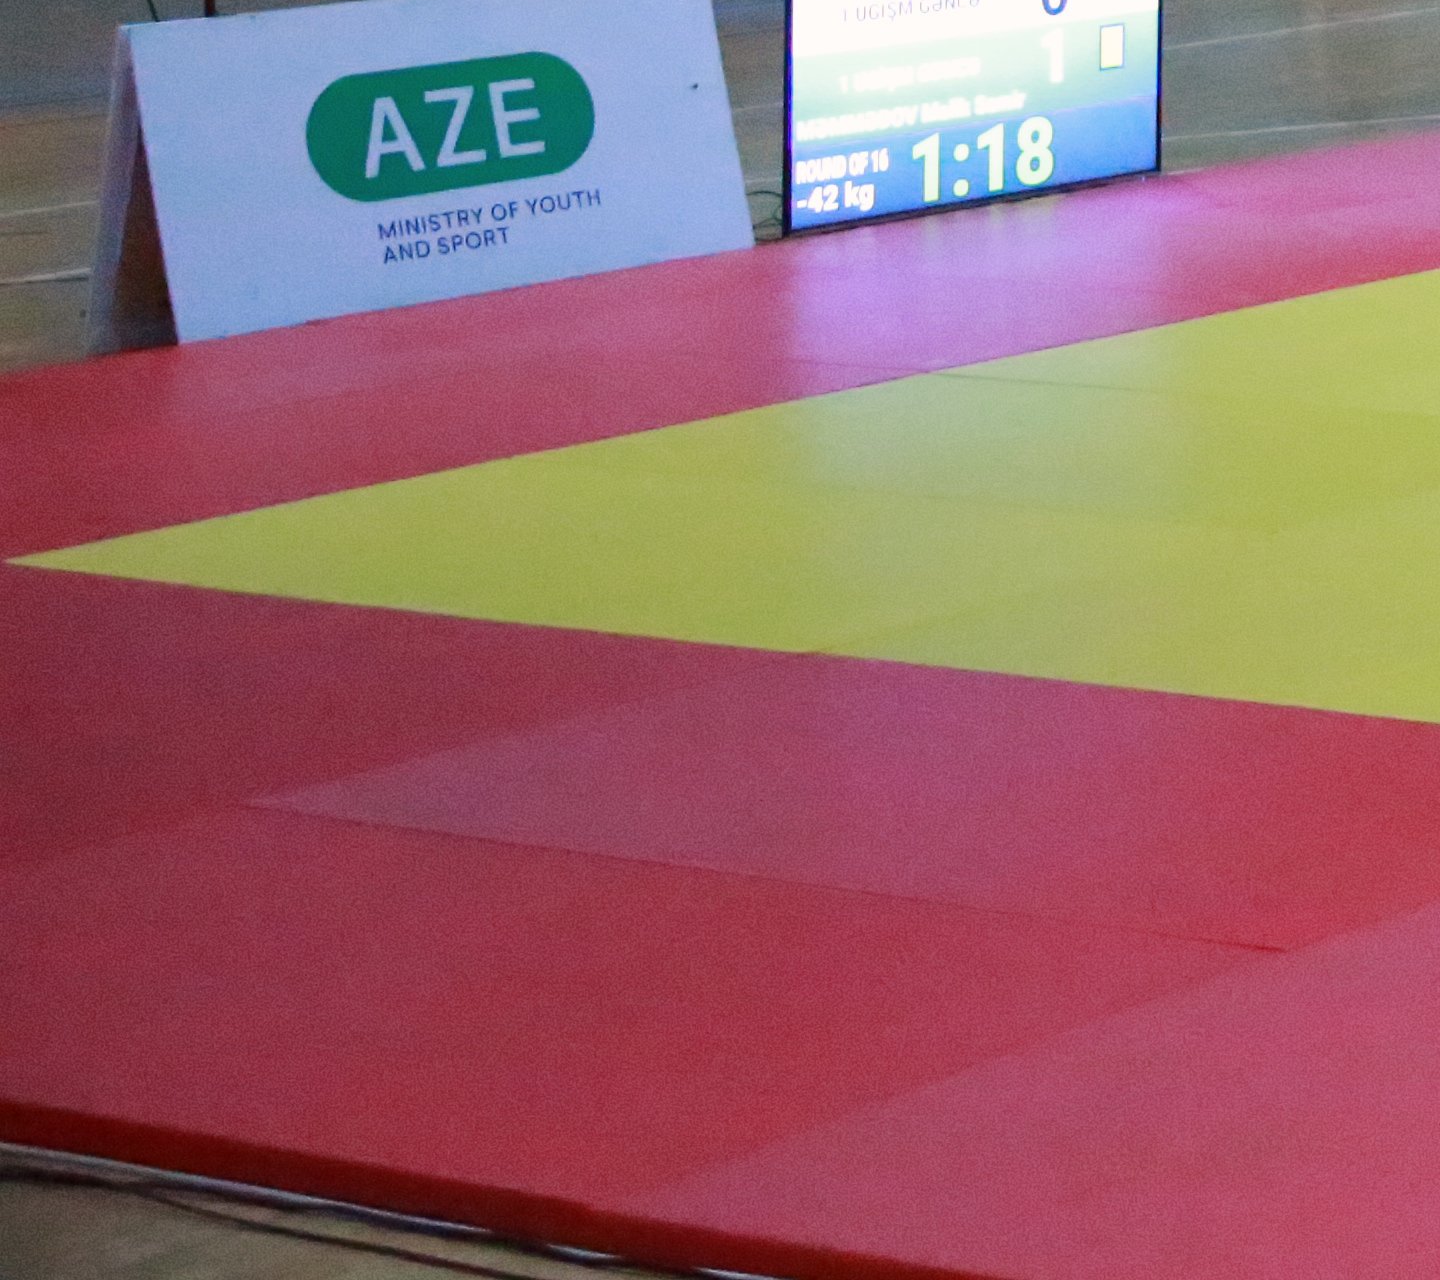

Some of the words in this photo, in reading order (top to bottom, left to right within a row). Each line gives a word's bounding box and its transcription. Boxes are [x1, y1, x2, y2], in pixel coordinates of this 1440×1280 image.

[1041, 27, 1065, 84] 1
[365, 77, 547, 179] AZE
[796, 153, 848, 185] ROUND
[849, 150, 870, 176] OF
[911, 115, 1056, 204] 1:18
[377, 207, 483, 241] MINISTRY
[491, 201, 520, 222] OF
[525, 189, 602, 217] YOUTH
[844, 180, 876, 213] kg
[383, 240, 431, 265] AND
[437, 226, 511, 255] SPORT
